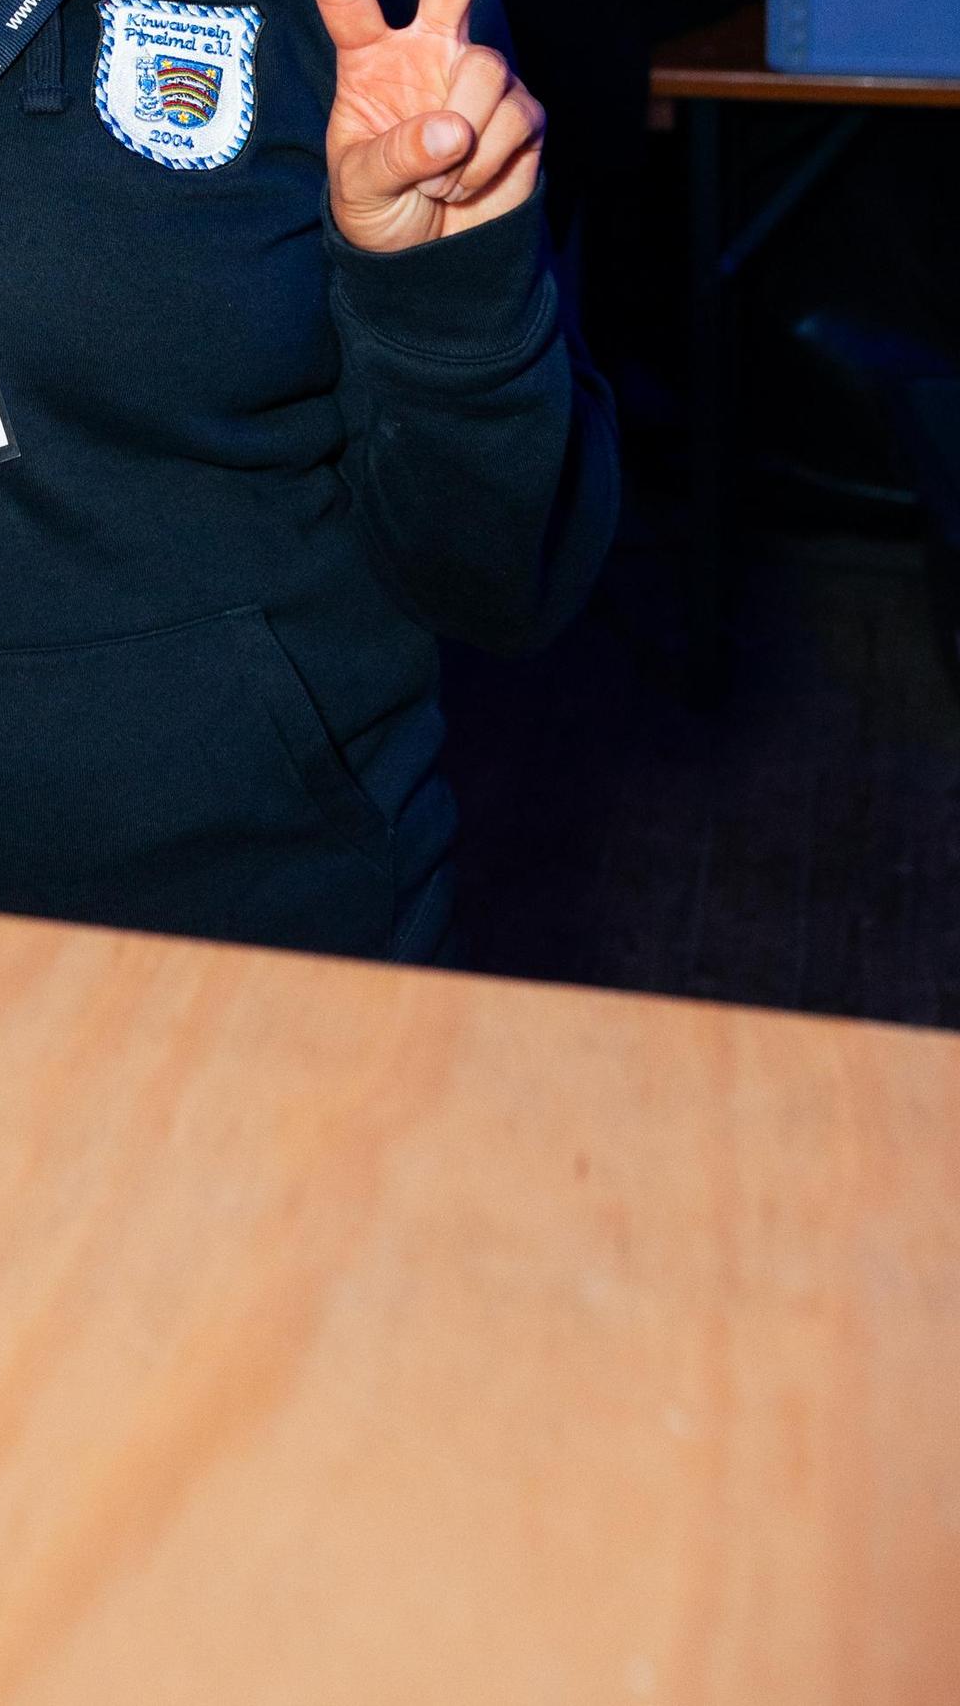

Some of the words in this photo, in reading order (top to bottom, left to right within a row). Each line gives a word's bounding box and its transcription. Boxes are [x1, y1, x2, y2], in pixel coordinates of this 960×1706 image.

[124, 13, 233, 41] Kirwaverein
[203, 43, 233, 57] e.V.
[148, 129, 195, 150] 2004
